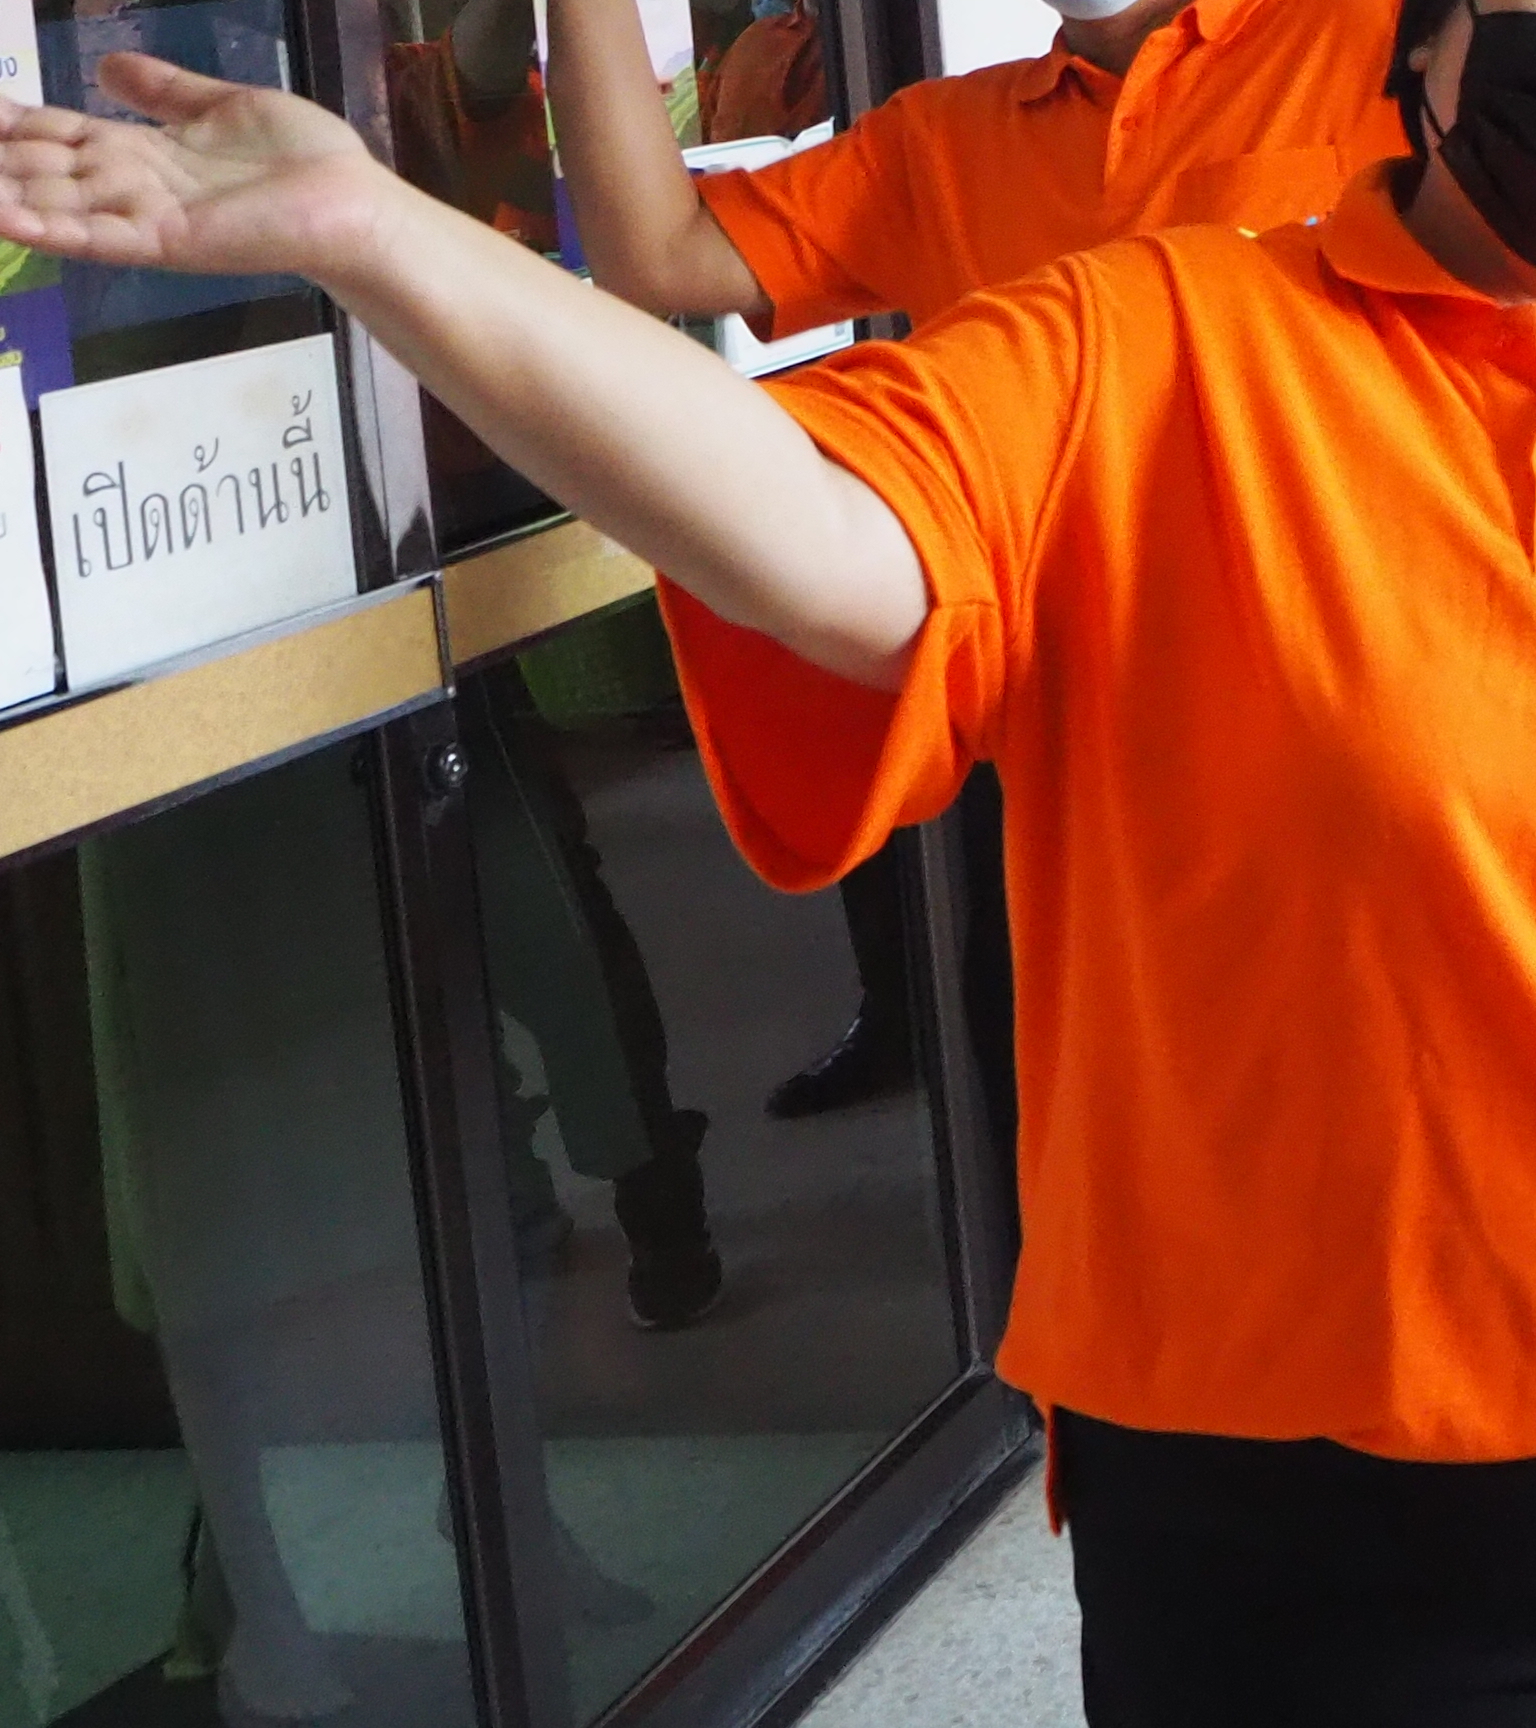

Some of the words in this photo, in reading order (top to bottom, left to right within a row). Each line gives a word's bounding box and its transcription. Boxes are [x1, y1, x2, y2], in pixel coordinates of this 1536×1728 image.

[70, 388, 332, 578] เปิดด้านนี้
